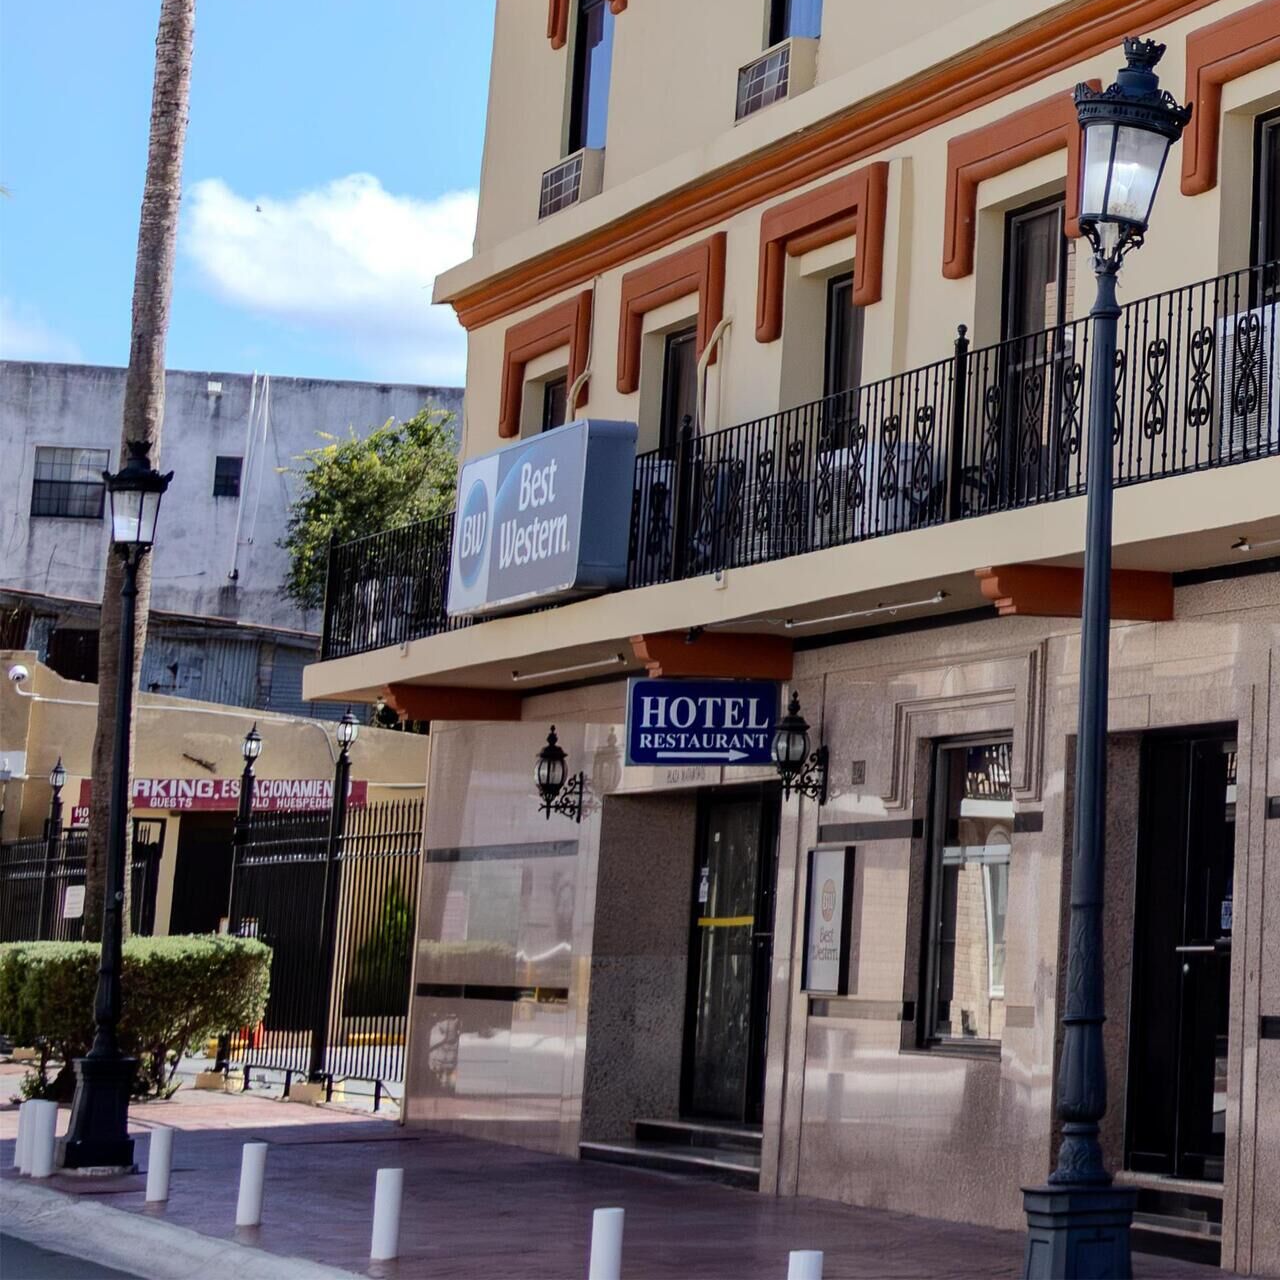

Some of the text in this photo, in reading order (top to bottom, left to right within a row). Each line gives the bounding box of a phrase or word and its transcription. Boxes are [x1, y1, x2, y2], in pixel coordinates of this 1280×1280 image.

[519, 458, 557, 511] Best
[461, 512, 486, 559] BW
[640, 696, 769, 728] HOTEL
[639, 733, 768, 749] RESTAURANT
[132, 779, 219, 800] RKING,
